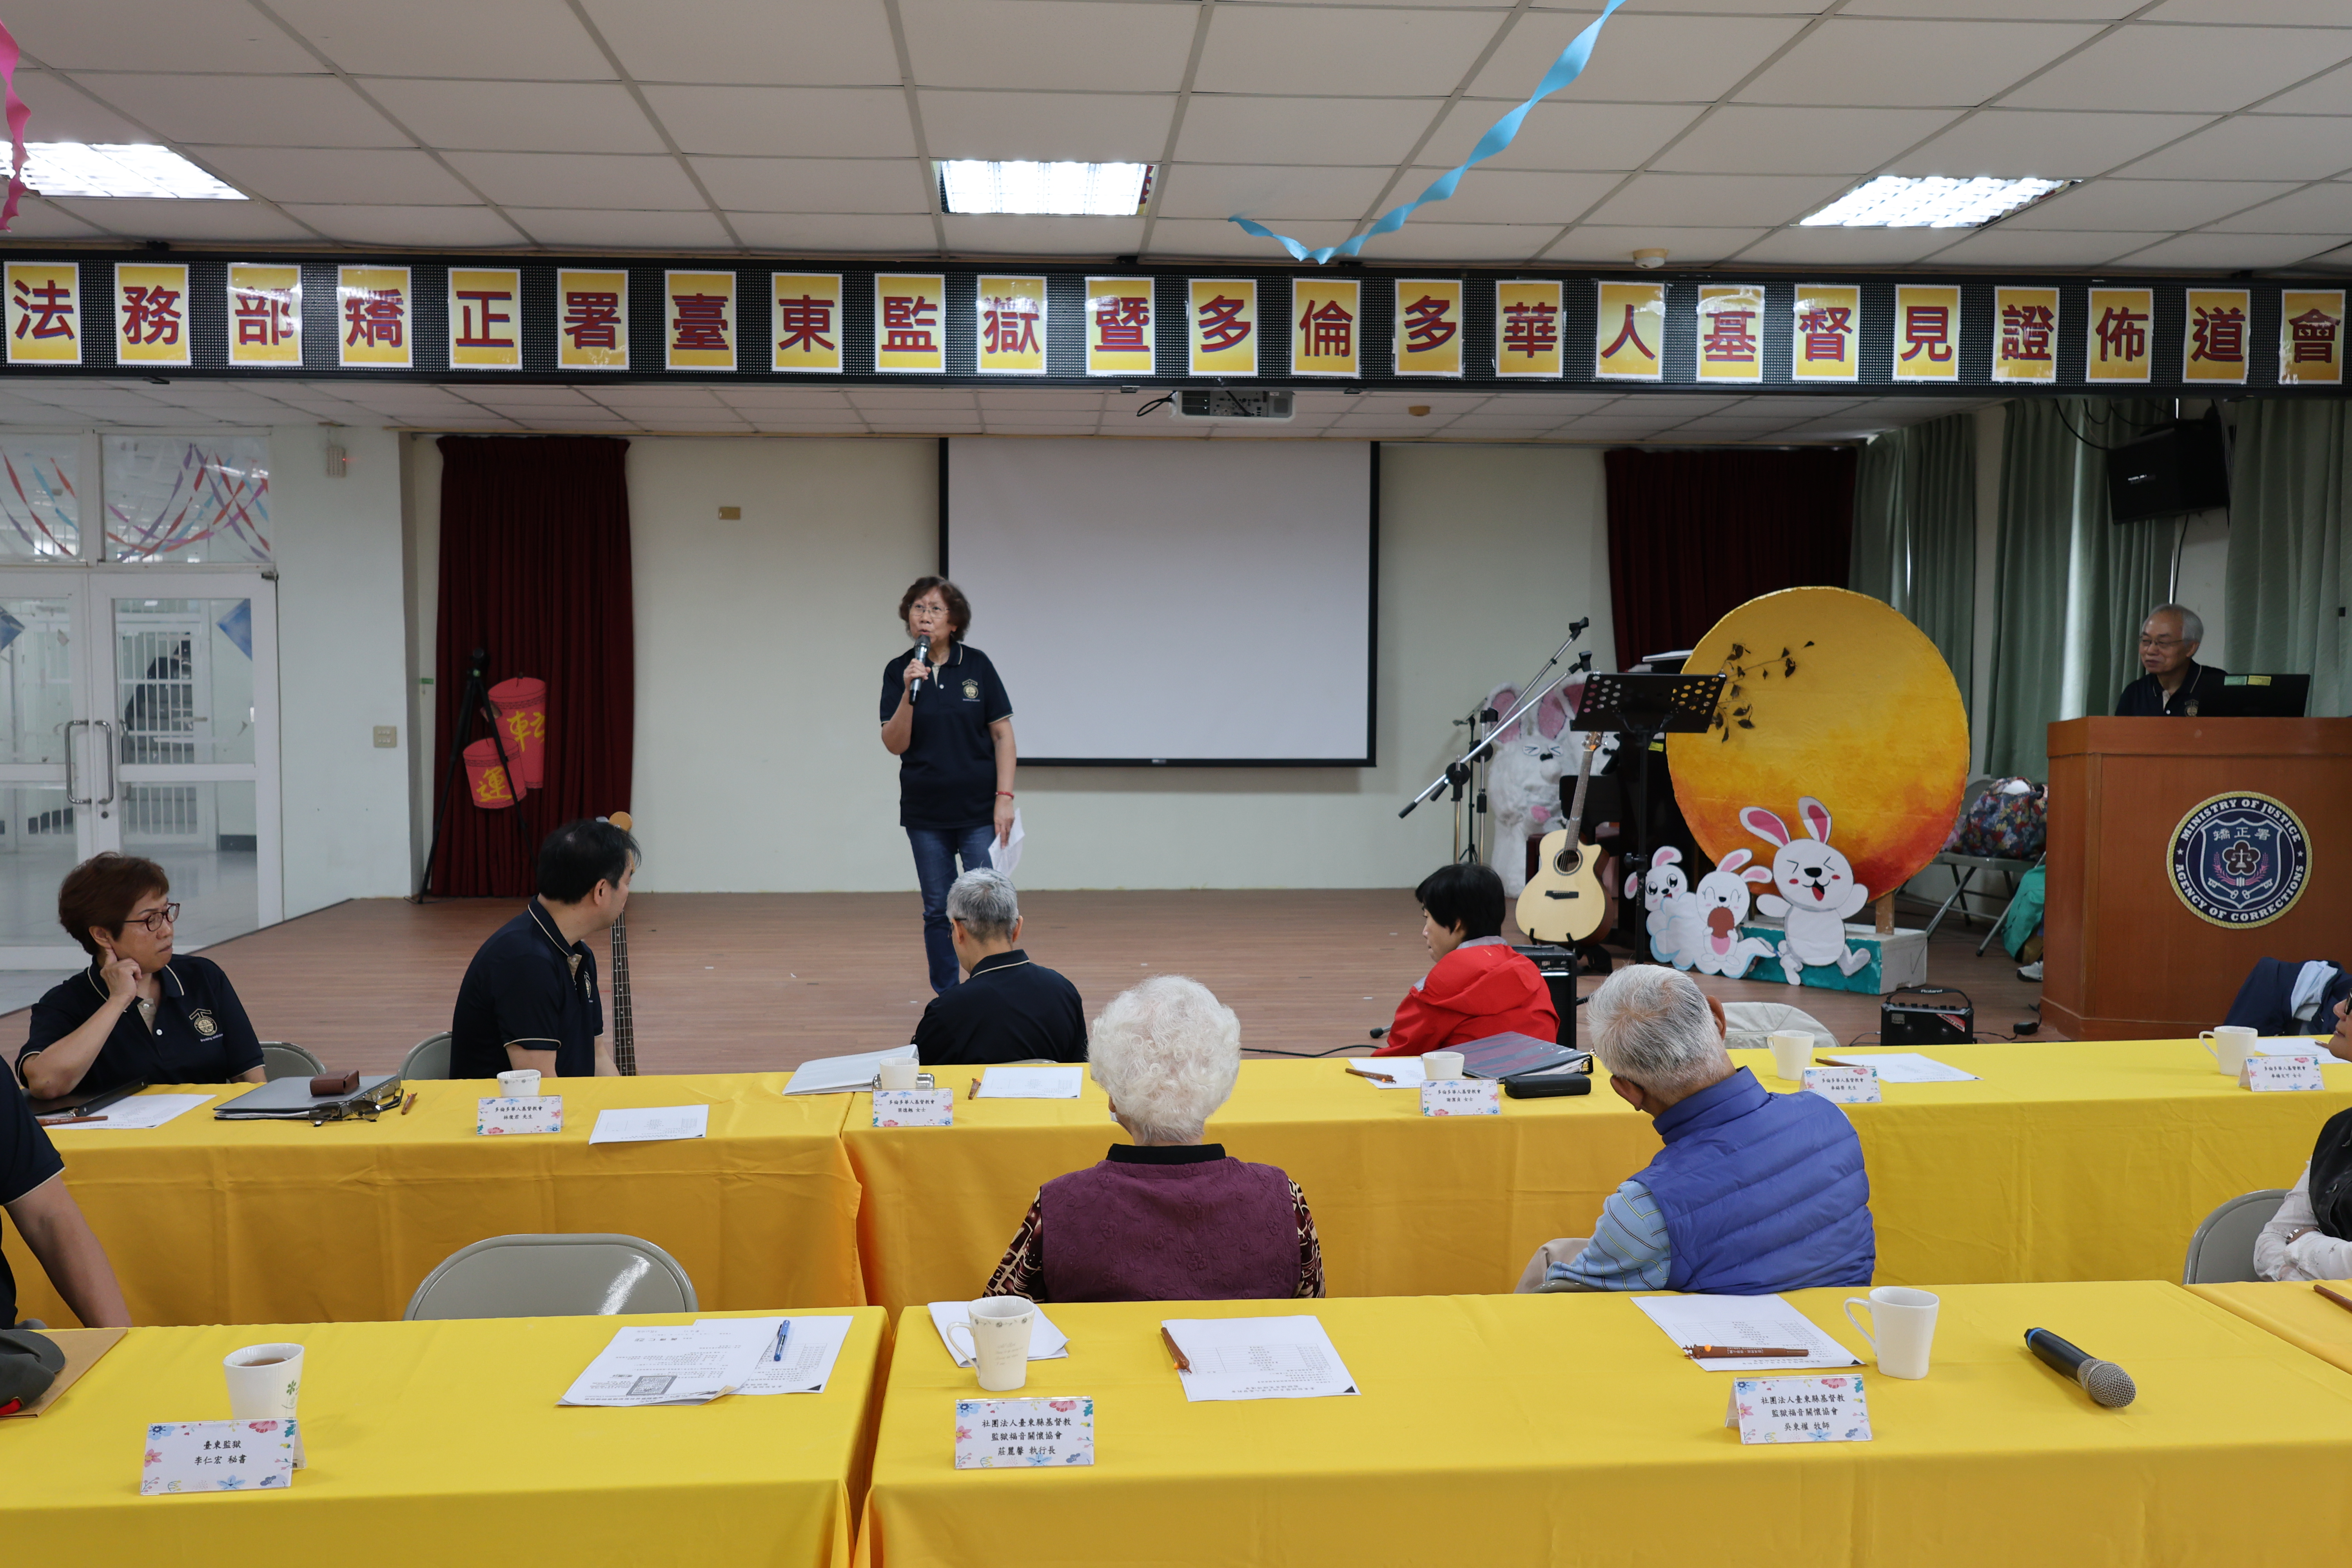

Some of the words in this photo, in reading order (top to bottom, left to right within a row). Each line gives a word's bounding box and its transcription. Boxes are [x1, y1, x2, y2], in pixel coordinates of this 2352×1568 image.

[13, 278, 2341, 363] 法務部矯正署臺東監獄暨多倫多華人基督見證佈道會
[476, 766, 512, 802] 運
[2181, 799, 2237, 841] MINISTRY
[2242, 798, 2259, 808] OF
[2262, 803, 2301, 842] JUSTICE
[2213, 827, 2270, 841] 矯正署
[2176, 864, 2209, 909] AGENCY
[2209, 907, 2227, 919] OF
[2230, 865, 2304, 922] CORRECTIONS
[1760, 1394, 1845, 1405] 社團法人臺東縣基督教
[1771, 1406, 1838, 1417] 監獄福音關懷協會
[982, 1417, 1072, 1428] 社團法人臺東縣基督教
[1784, 1422, 1809, 1431] 吳東權
[1813, 1421, 1830, 1430] 牧師
[991, 1431, 1063, 1441] 監獄福音關懷協會
[203, 1440, 241, 1450] 臺東監獄
[998, 1446, 1024, 1456] 莊麗馨
[1029, 1445, 1056, 1455] 執行長
[194, 1455, 223, 1466] 李仁宏
[227, 1454, 247, 1464] 秘書
